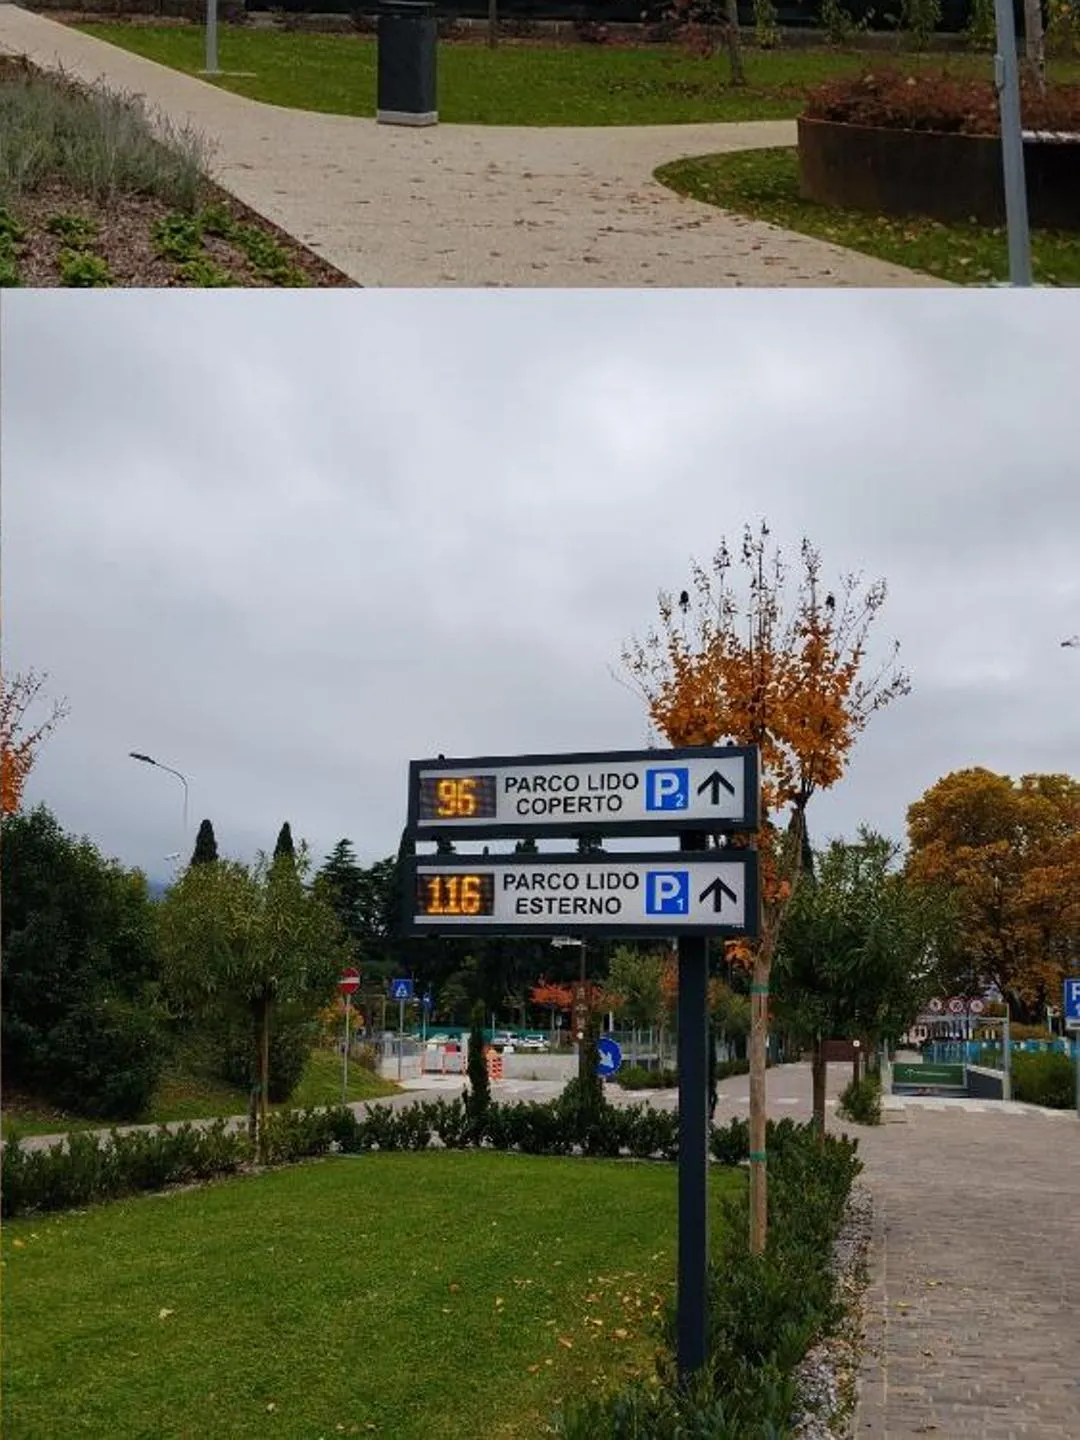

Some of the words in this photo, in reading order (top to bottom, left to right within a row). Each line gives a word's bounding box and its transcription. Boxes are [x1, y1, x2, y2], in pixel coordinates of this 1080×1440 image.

[505, 776, 580, 793] PARCO
[588, 773, 639, 791] LIDO
[516, 794, 622, 815] COPERTO
[503, 873, 579, 891] PARCO
[587, 873, 639, 891] LIDO
[427, 875, 481, 914] 116
[516, 897, 621, 916] ESTERNO
